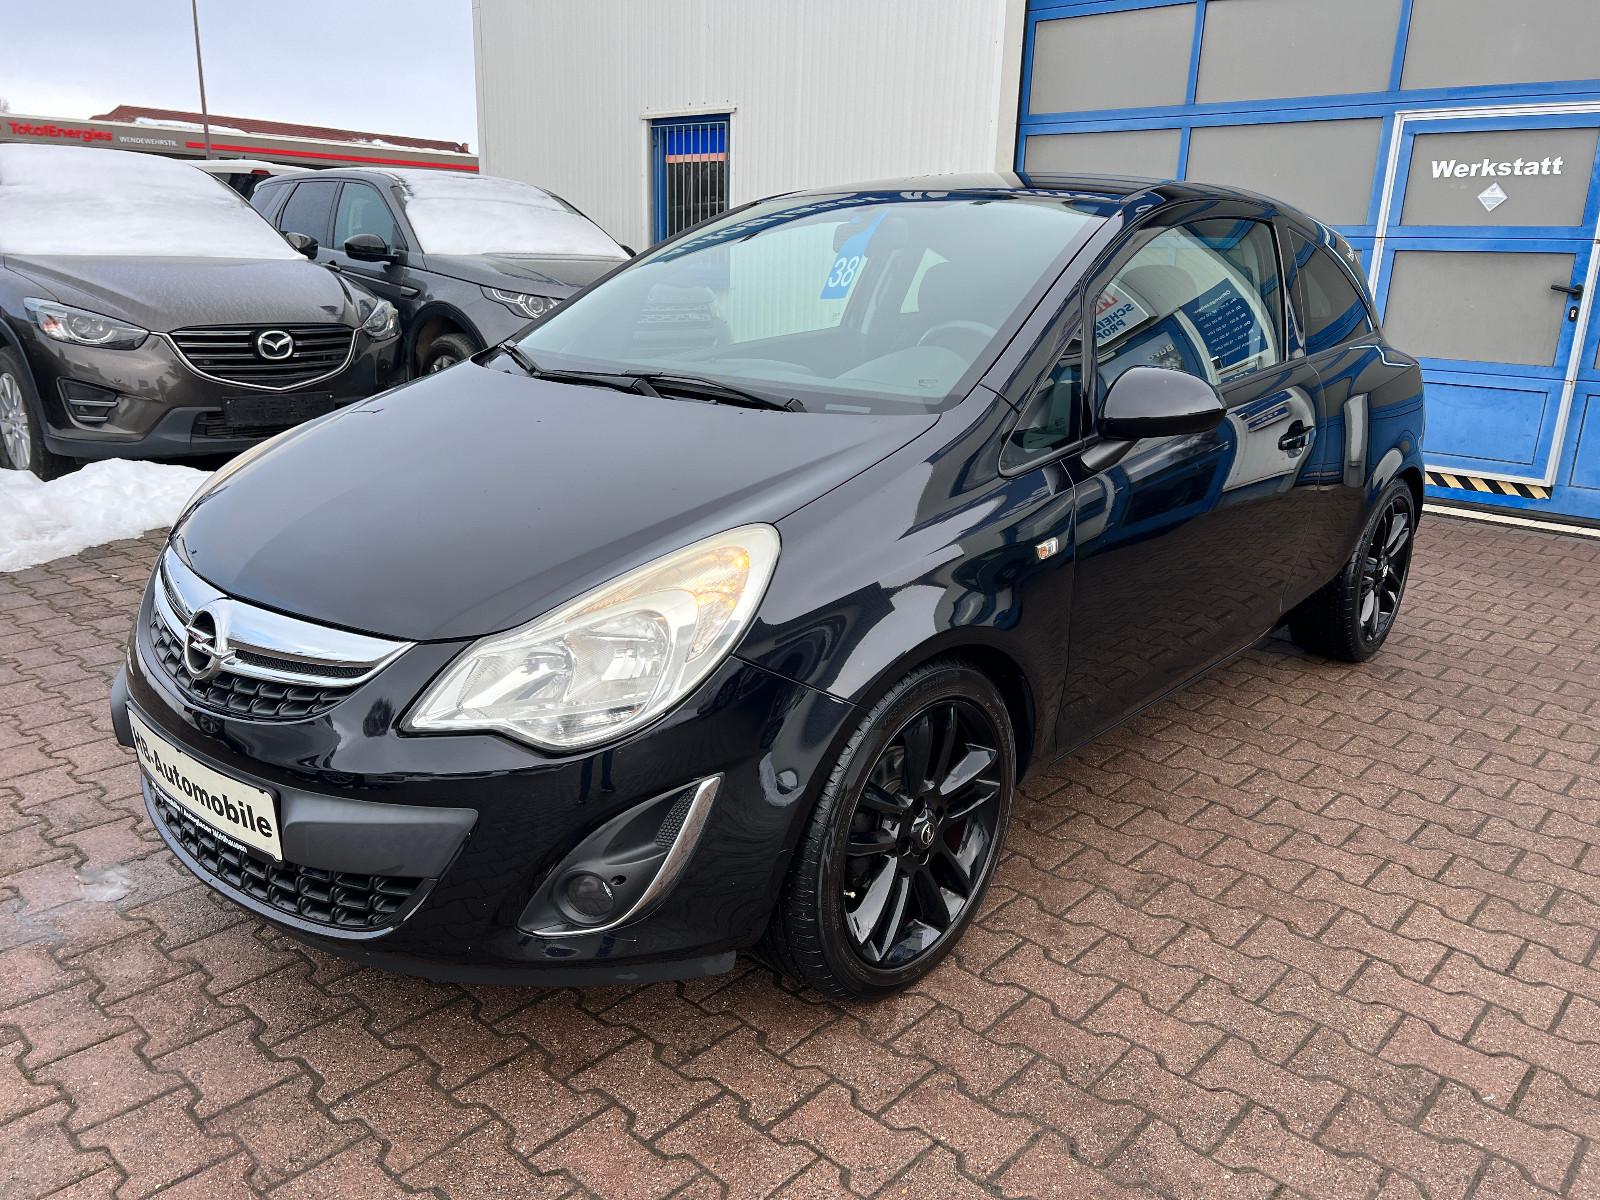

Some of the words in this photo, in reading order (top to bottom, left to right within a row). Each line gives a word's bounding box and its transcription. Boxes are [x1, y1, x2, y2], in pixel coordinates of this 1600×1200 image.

[8, 121, 113, 142] TotalEnergies
[1432, 156, 1563, 178] Werkstatt
[828, 255, 859, 288] 38
[132, 726, 273, 838] HB-Automobile
